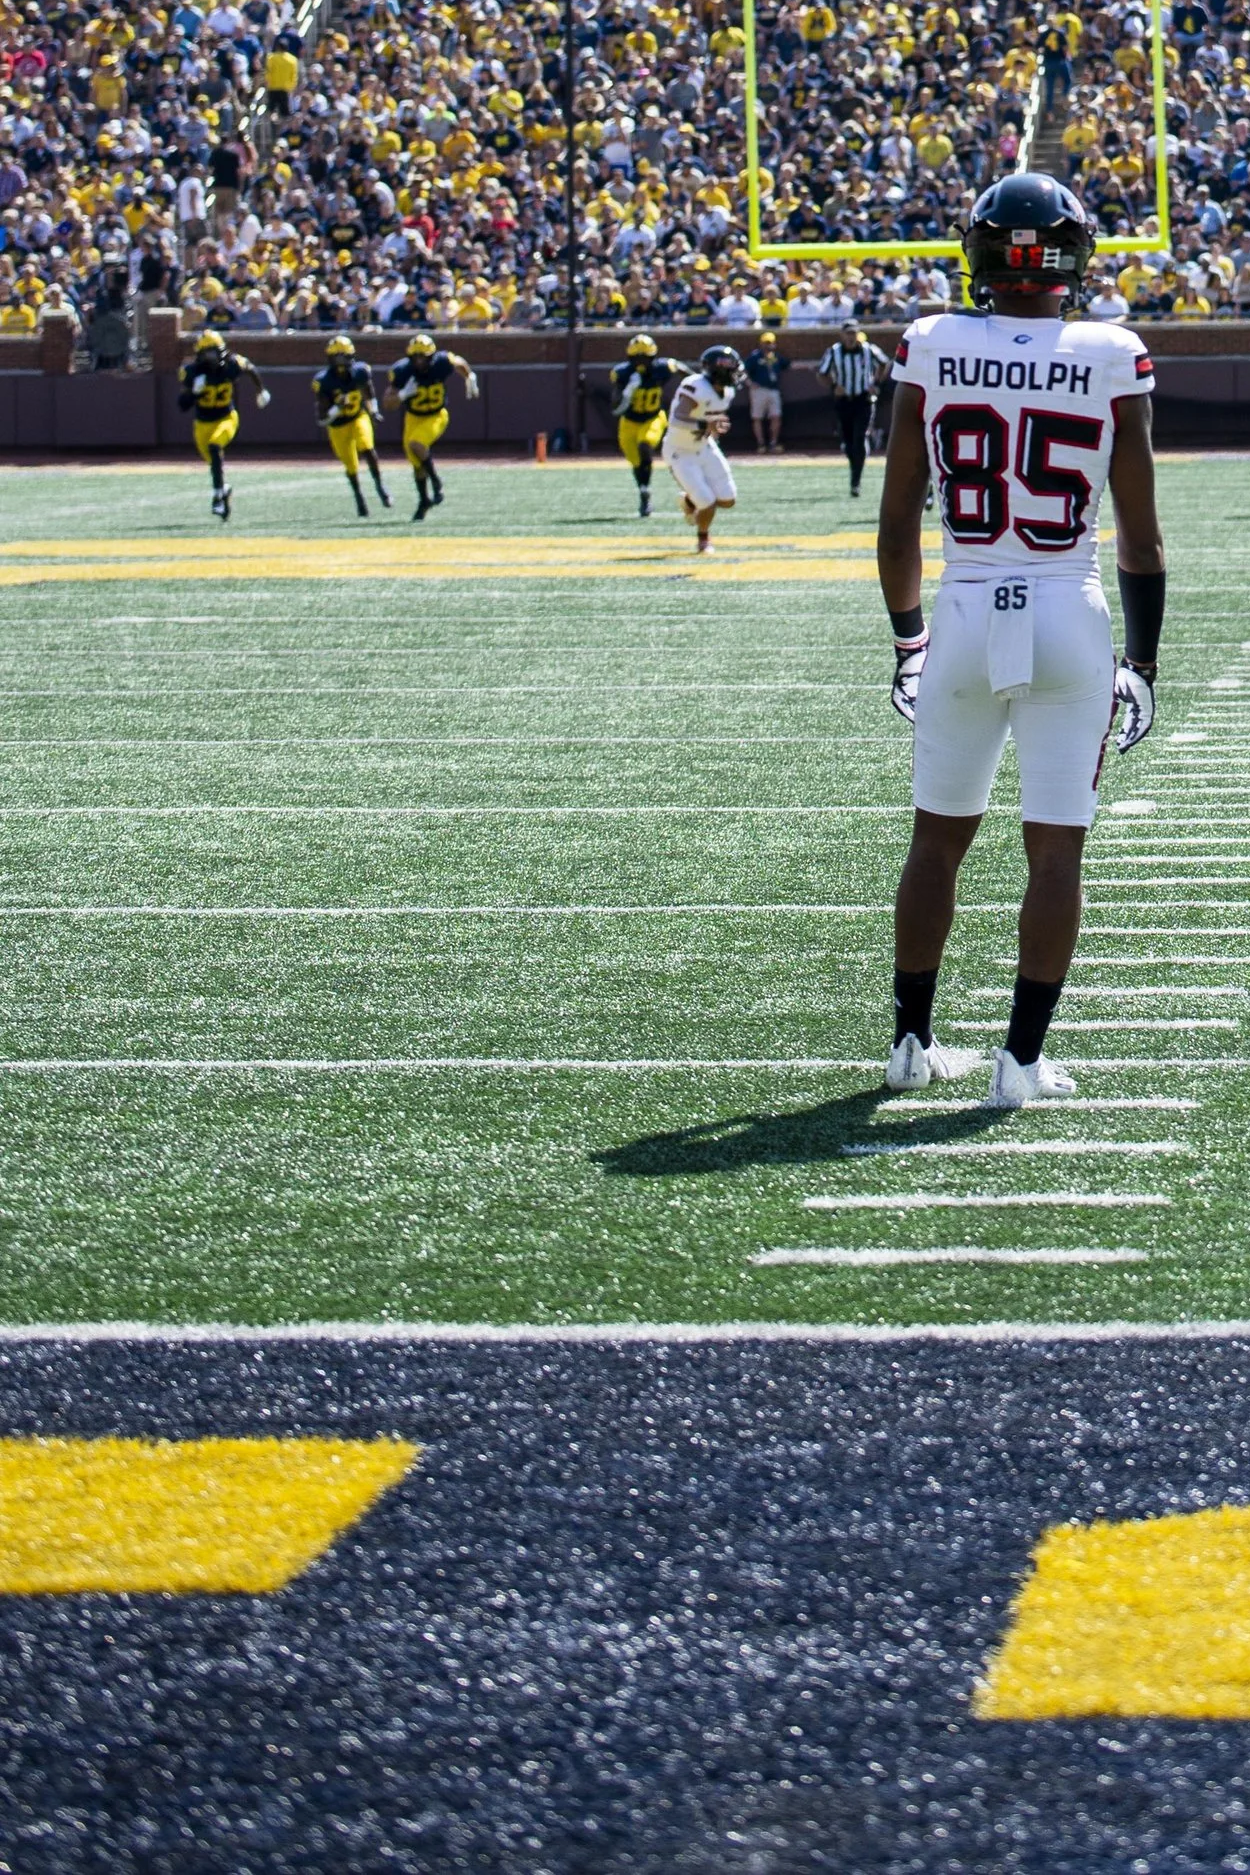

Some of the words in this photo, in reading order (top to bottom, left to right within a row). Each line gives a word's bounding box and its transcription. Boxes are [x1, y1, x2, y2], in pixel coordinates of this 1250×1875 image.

[938, 356, 1092, 396] RUDOLPH
[931, 403, 1105, 553] 85
[994, 585, 1028, 611] 85
